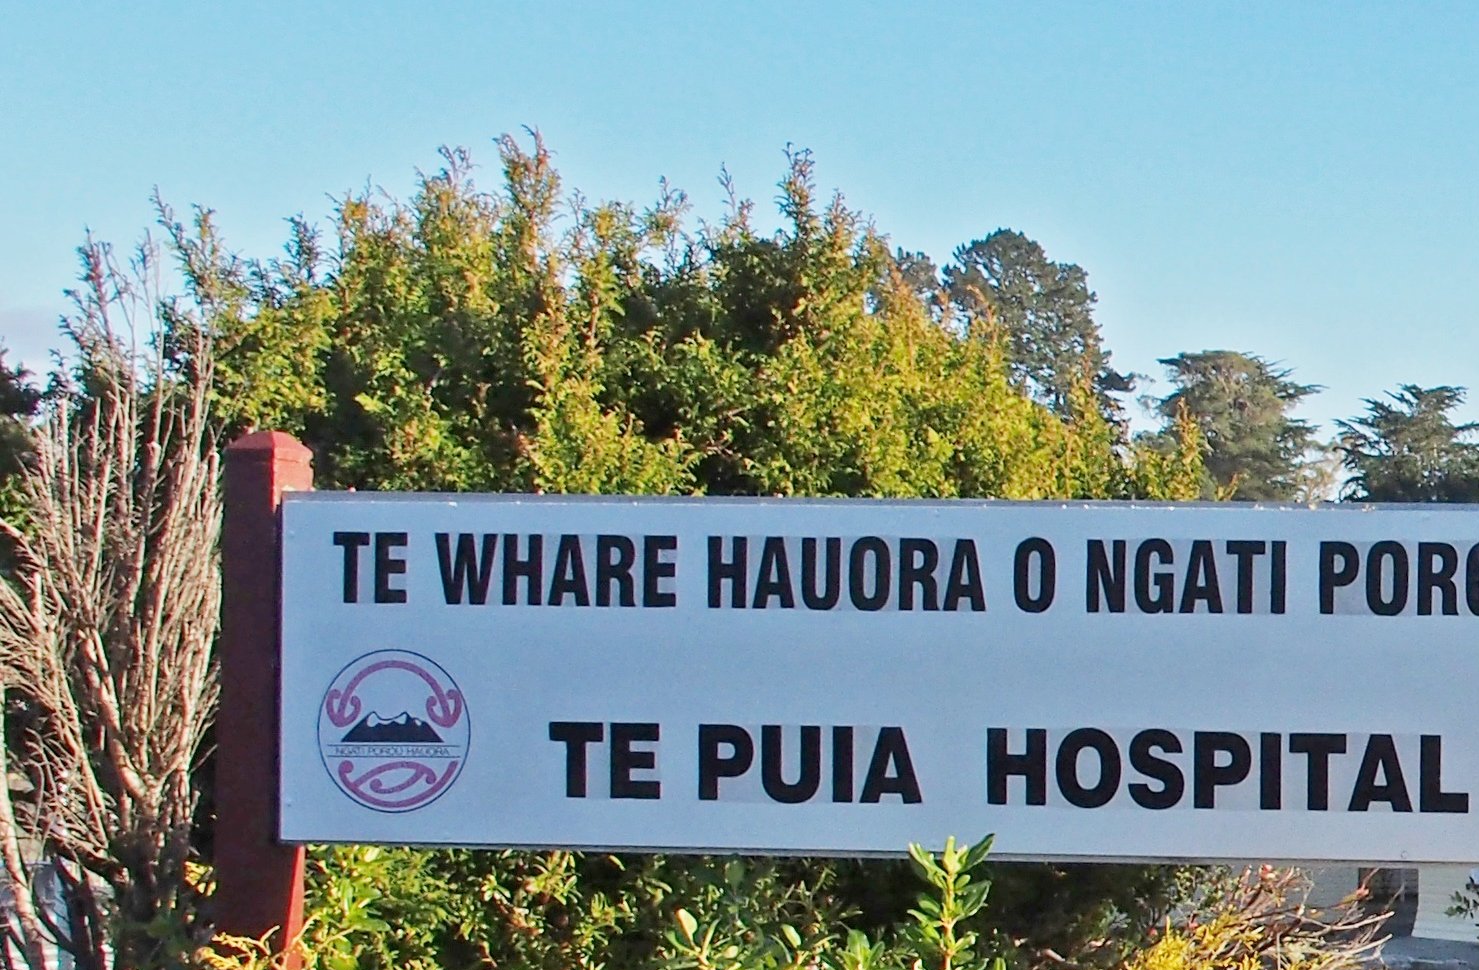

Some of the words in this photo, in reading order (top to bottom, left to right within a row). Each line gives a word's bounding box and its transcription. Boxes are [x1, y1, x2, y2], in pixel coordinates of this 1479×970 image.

[333, 531, 408, 604] TE
[434, 532, 678, 608] WHARE
[707, 535, 986, 612] HAUORA
[1013, 536, 1056, 614] O
[1085, 537, 1287, 615] NGATI
[548, 721, 661, 800] TE
[698, 723, 923, 805] PUIA
[986, 727, 1469, 814] HOSPITAL
